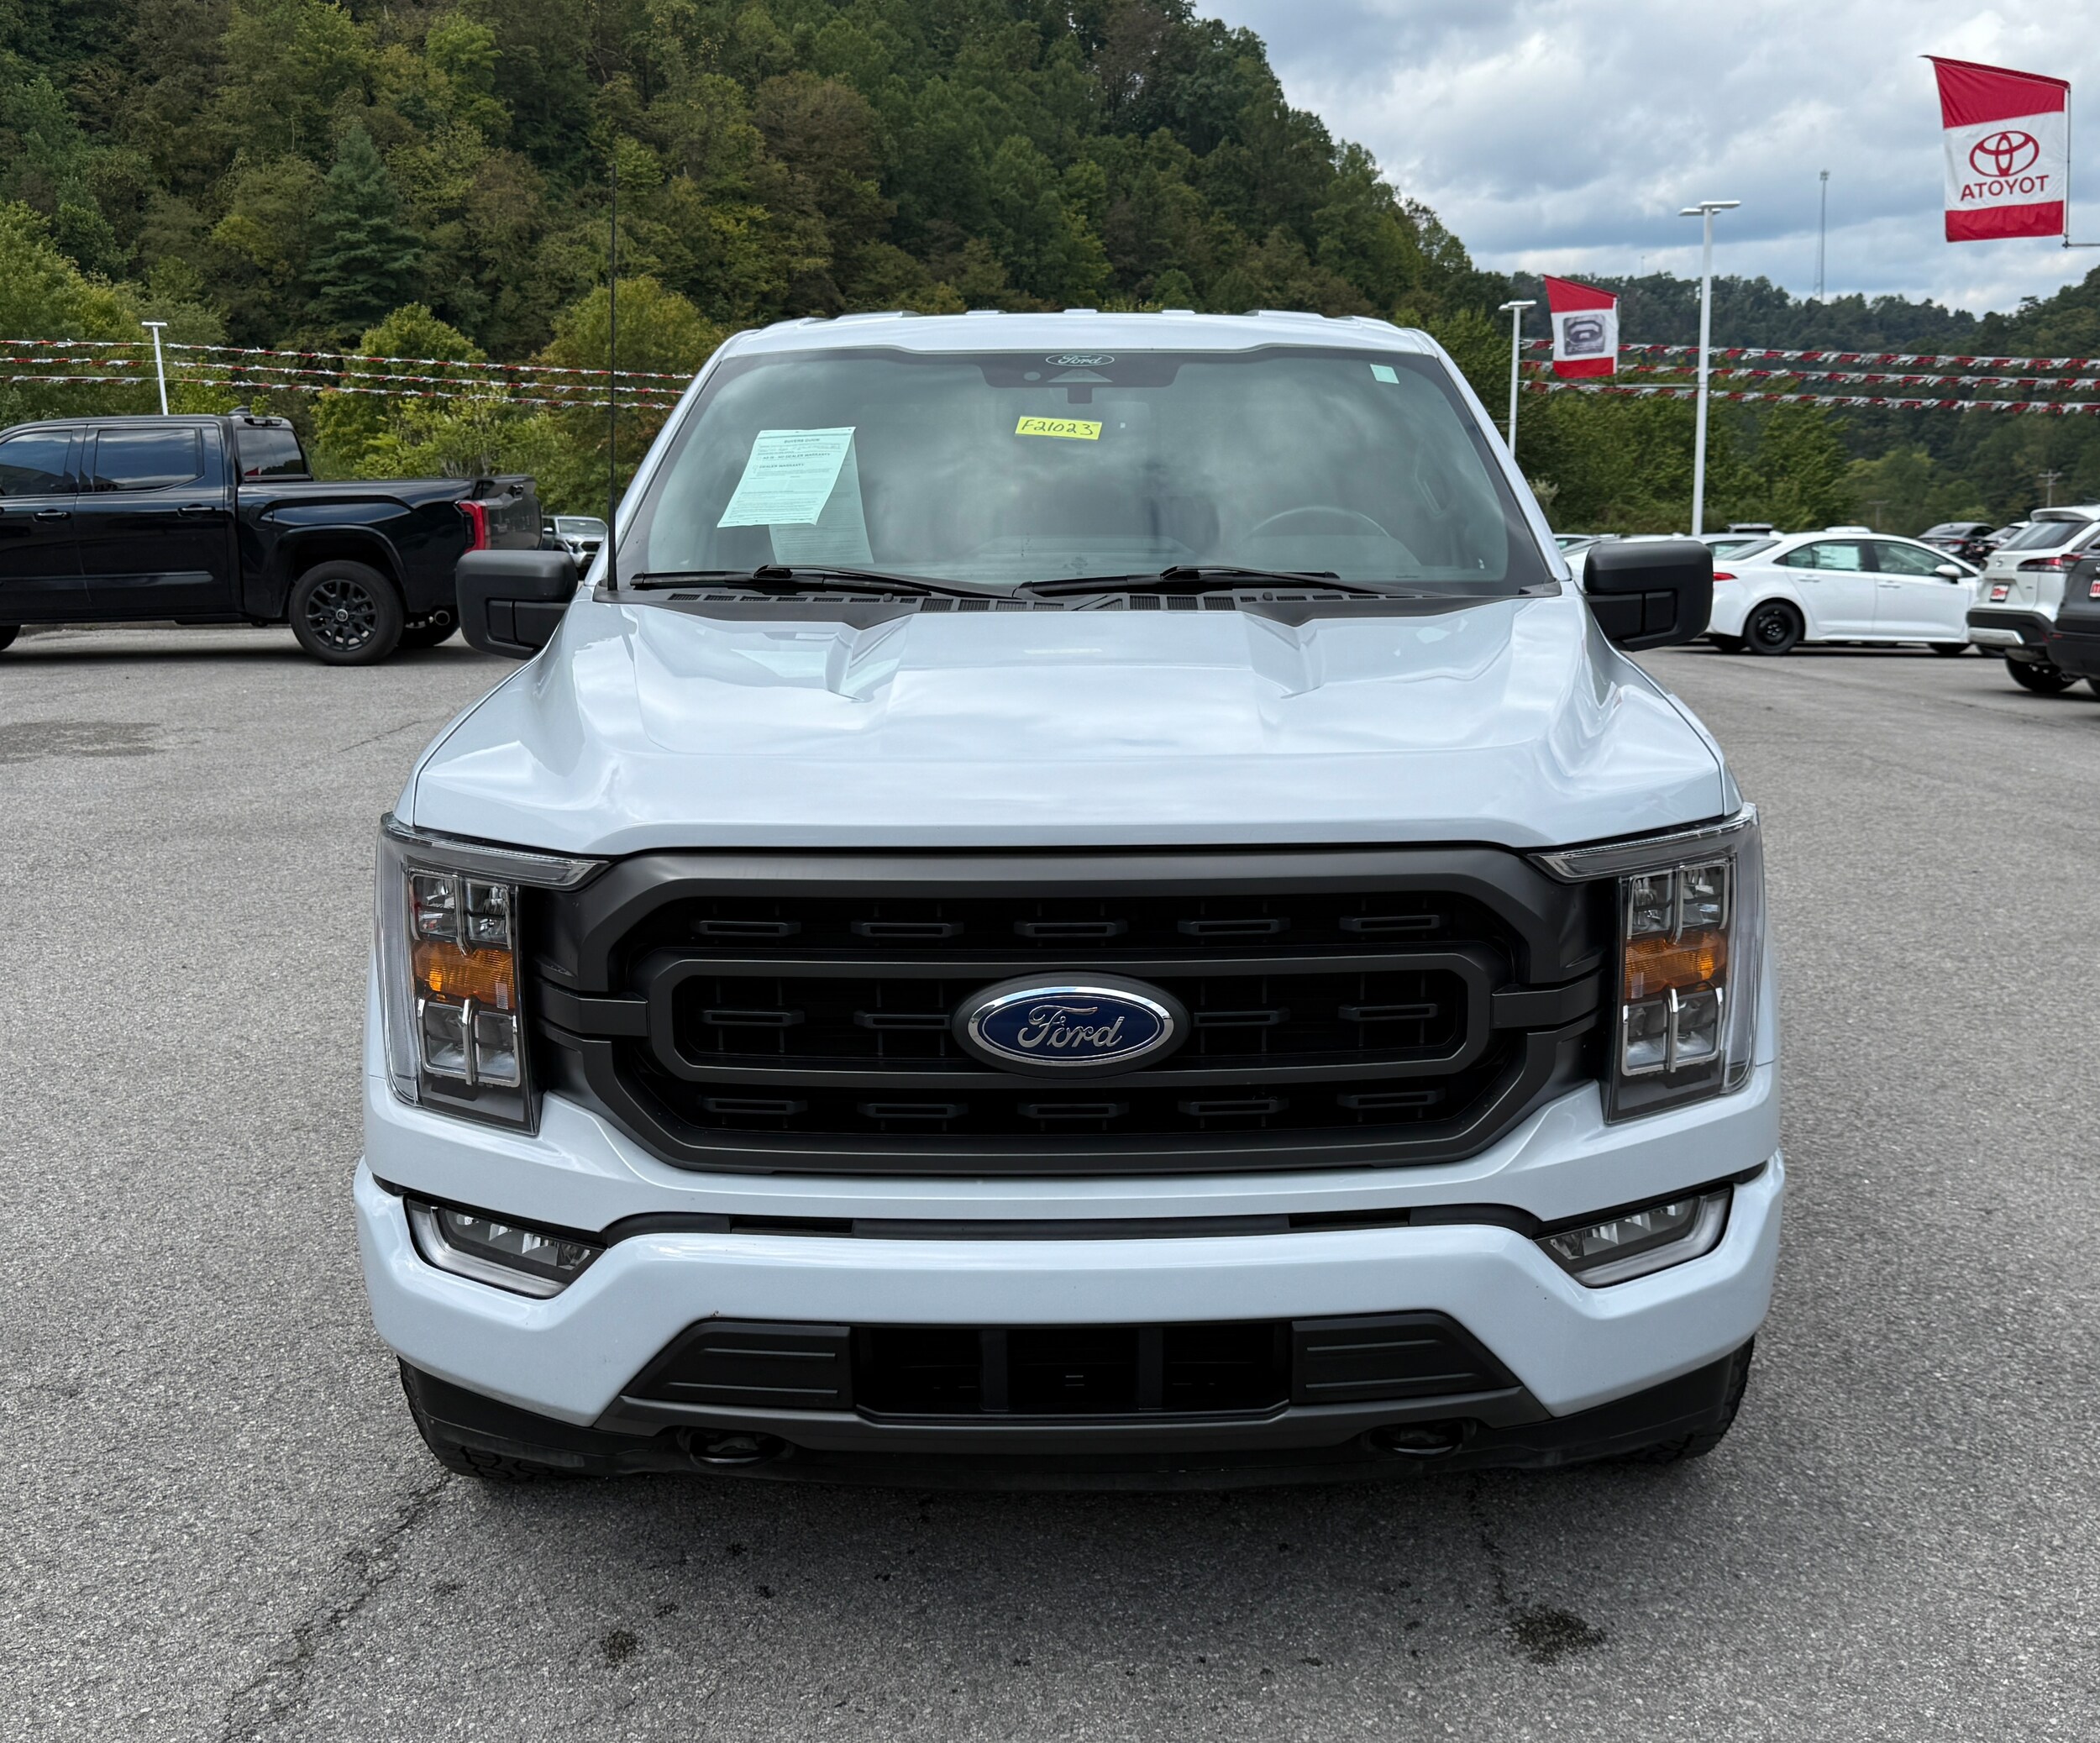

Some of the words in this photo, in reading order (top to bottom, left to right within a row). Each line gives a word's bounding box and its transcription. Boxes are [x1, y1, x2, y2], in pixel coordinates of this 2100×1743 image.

[1058, 354, 1103, 365] Ford
[1021, 418, 1094, 436] F21023
[1017, 1005, 1126, 1048] Ford
